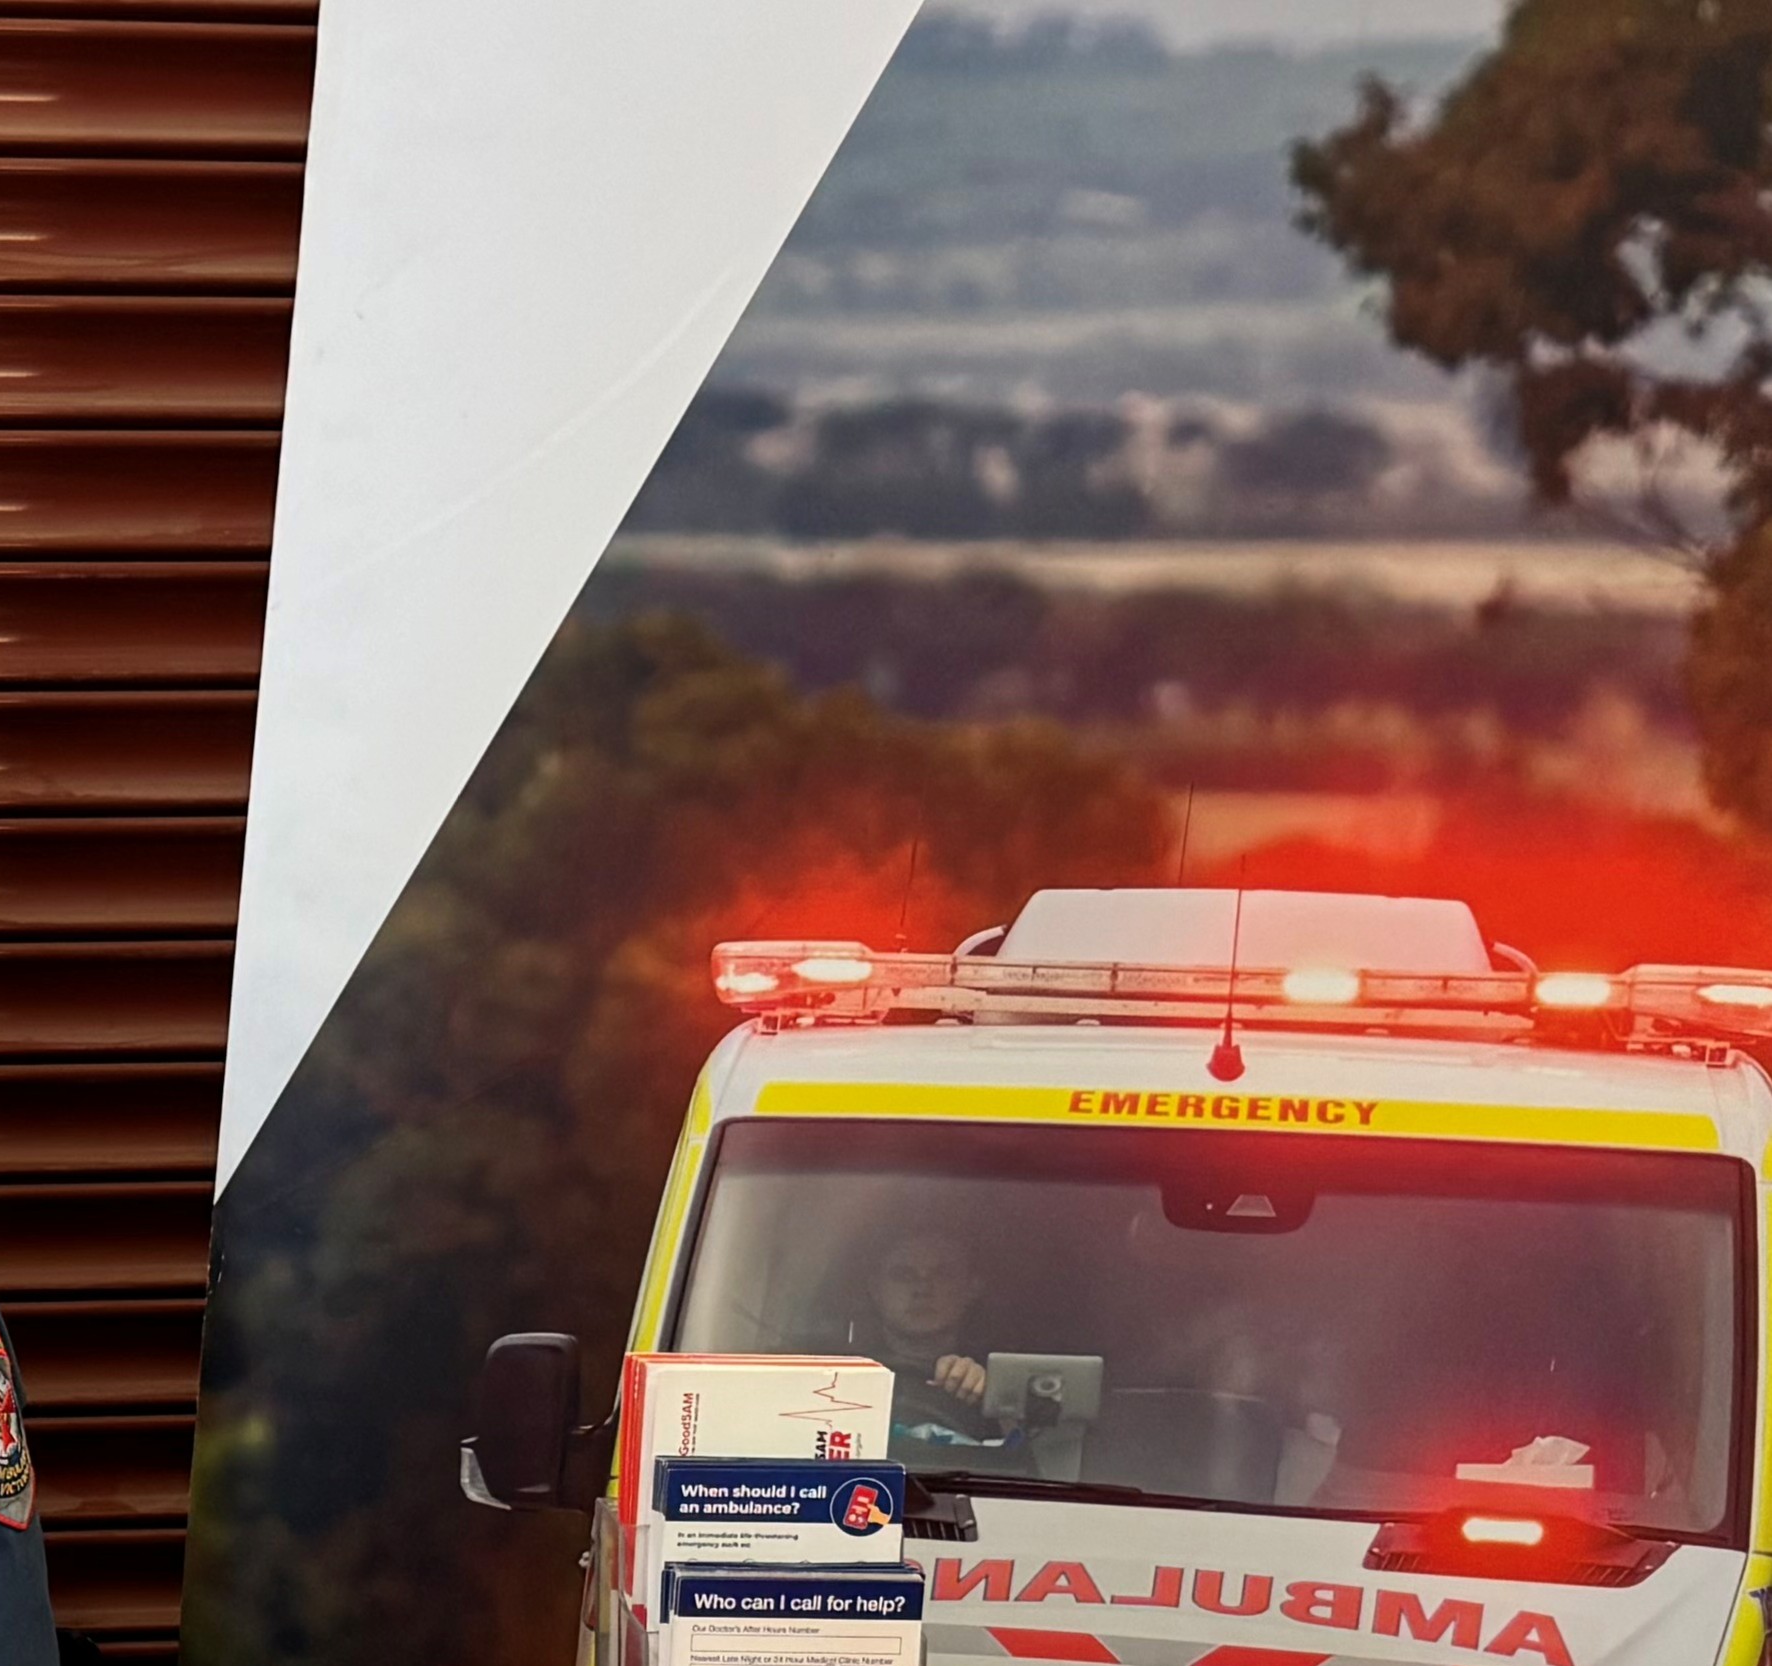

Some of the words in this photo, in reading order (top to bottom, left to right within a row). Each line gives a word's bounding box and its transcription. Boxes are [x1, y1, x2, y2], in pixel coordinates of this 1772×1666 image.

[1068, 1091, 1381, 1128] EMERGENCY
[681, 1485, 728, 1498] When
[732, 1484, 786, 1498] should
[790, 1485, 795, 1498] I
[799, 1485, 827, 1499] call
[679, 1504, 700, 1514] an
[703, 1502, 801, 1516] ambulance?
[694, 1594, 736, 1611] Who
[741, 1597, 774, 1611] can
[780, 1594, 785, 1611] I
[789, 1594, 822, 1612] call
[826, 1594, 853, 1612] for
[856, 1594, 906, 1614] help?
